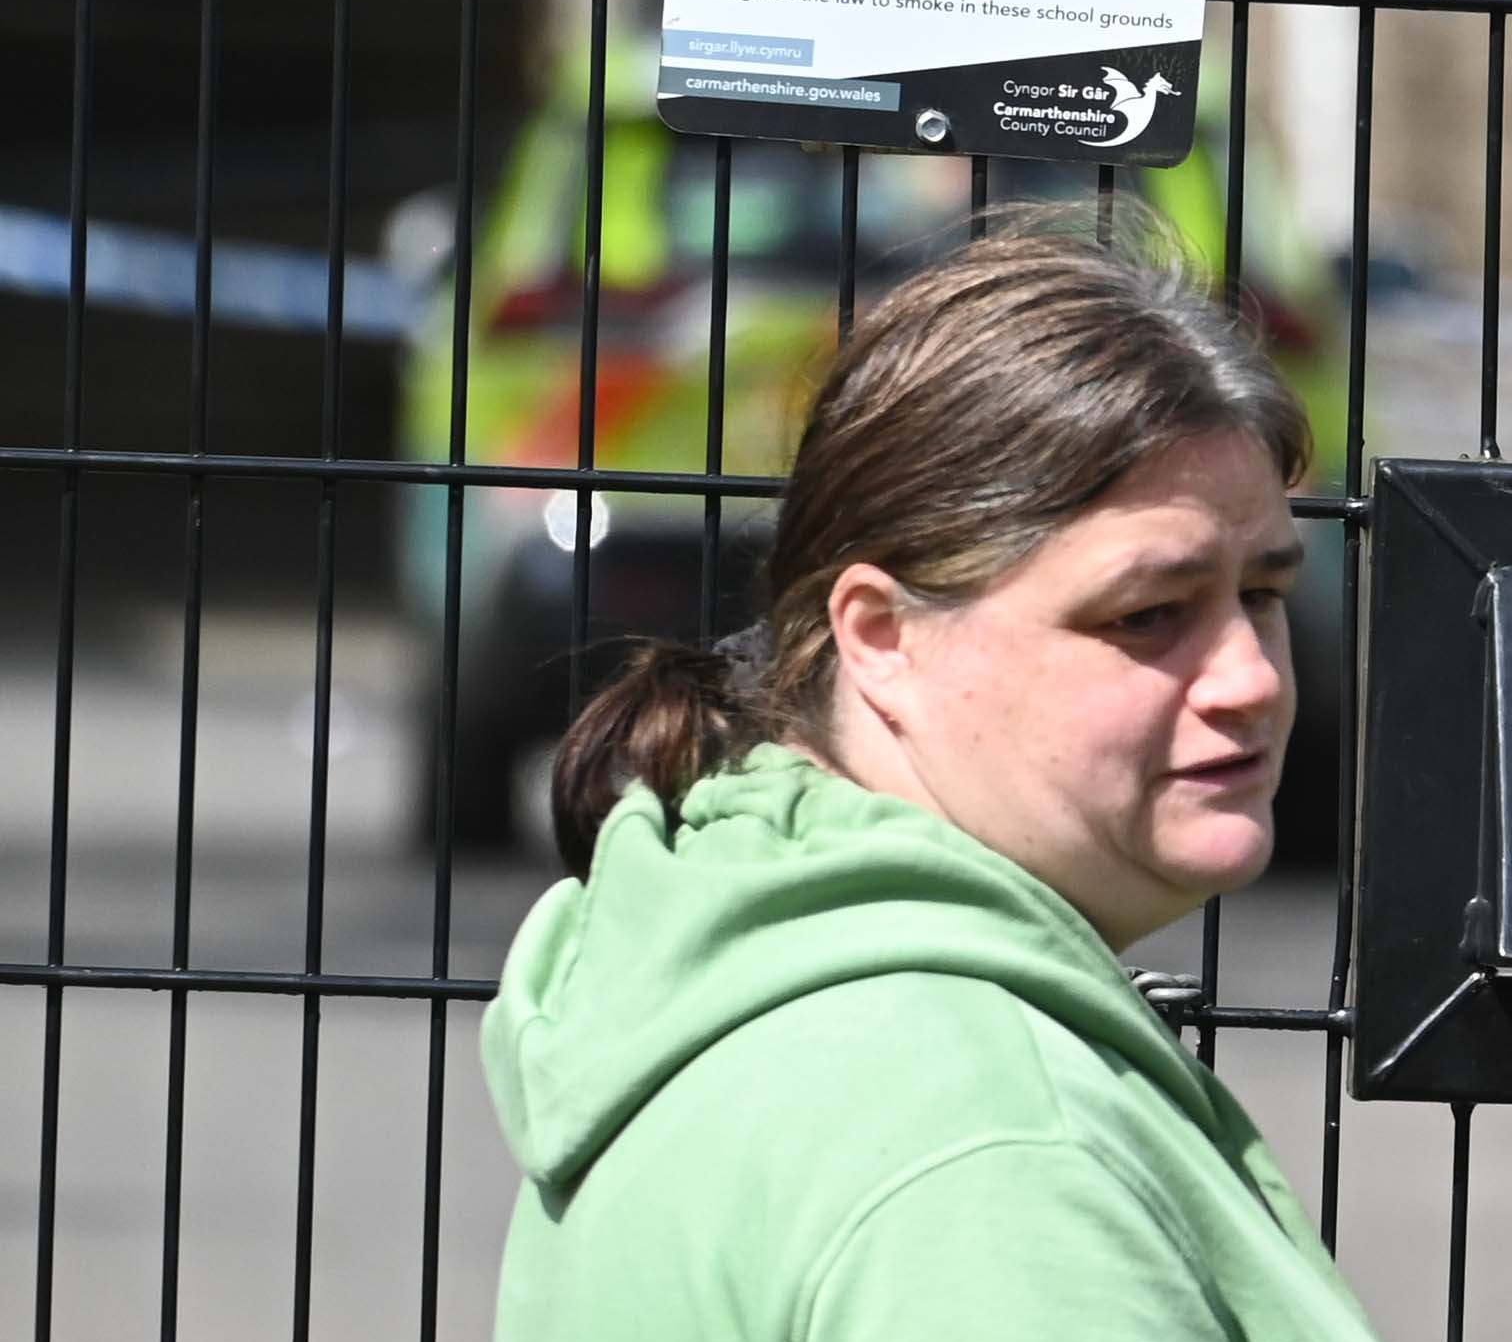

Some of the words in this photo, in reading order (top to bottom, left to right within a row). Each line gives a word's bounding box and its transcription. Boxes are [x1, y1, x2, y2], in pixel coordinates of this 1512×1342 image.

[982, 0, 1031, 18] these
[1037, 5, 1094, 23] school
[1100, 13, 1173, 29] grounds
[688, 39, 802, 59] sirgar.llyw.cymru
[685, 76, 881, 102] carmarthenshire.gov.wales
[1003, 80, 1055, 99] Cyngor
[1058, 83, 1077, 98] Sir
[1082, 85, 1110, 100] Gâr
[993, 102, 1116, 124] Carmarthenshire
[1000, 118, 1050, 136] County
[1054, 121, 1107, 137] Council
